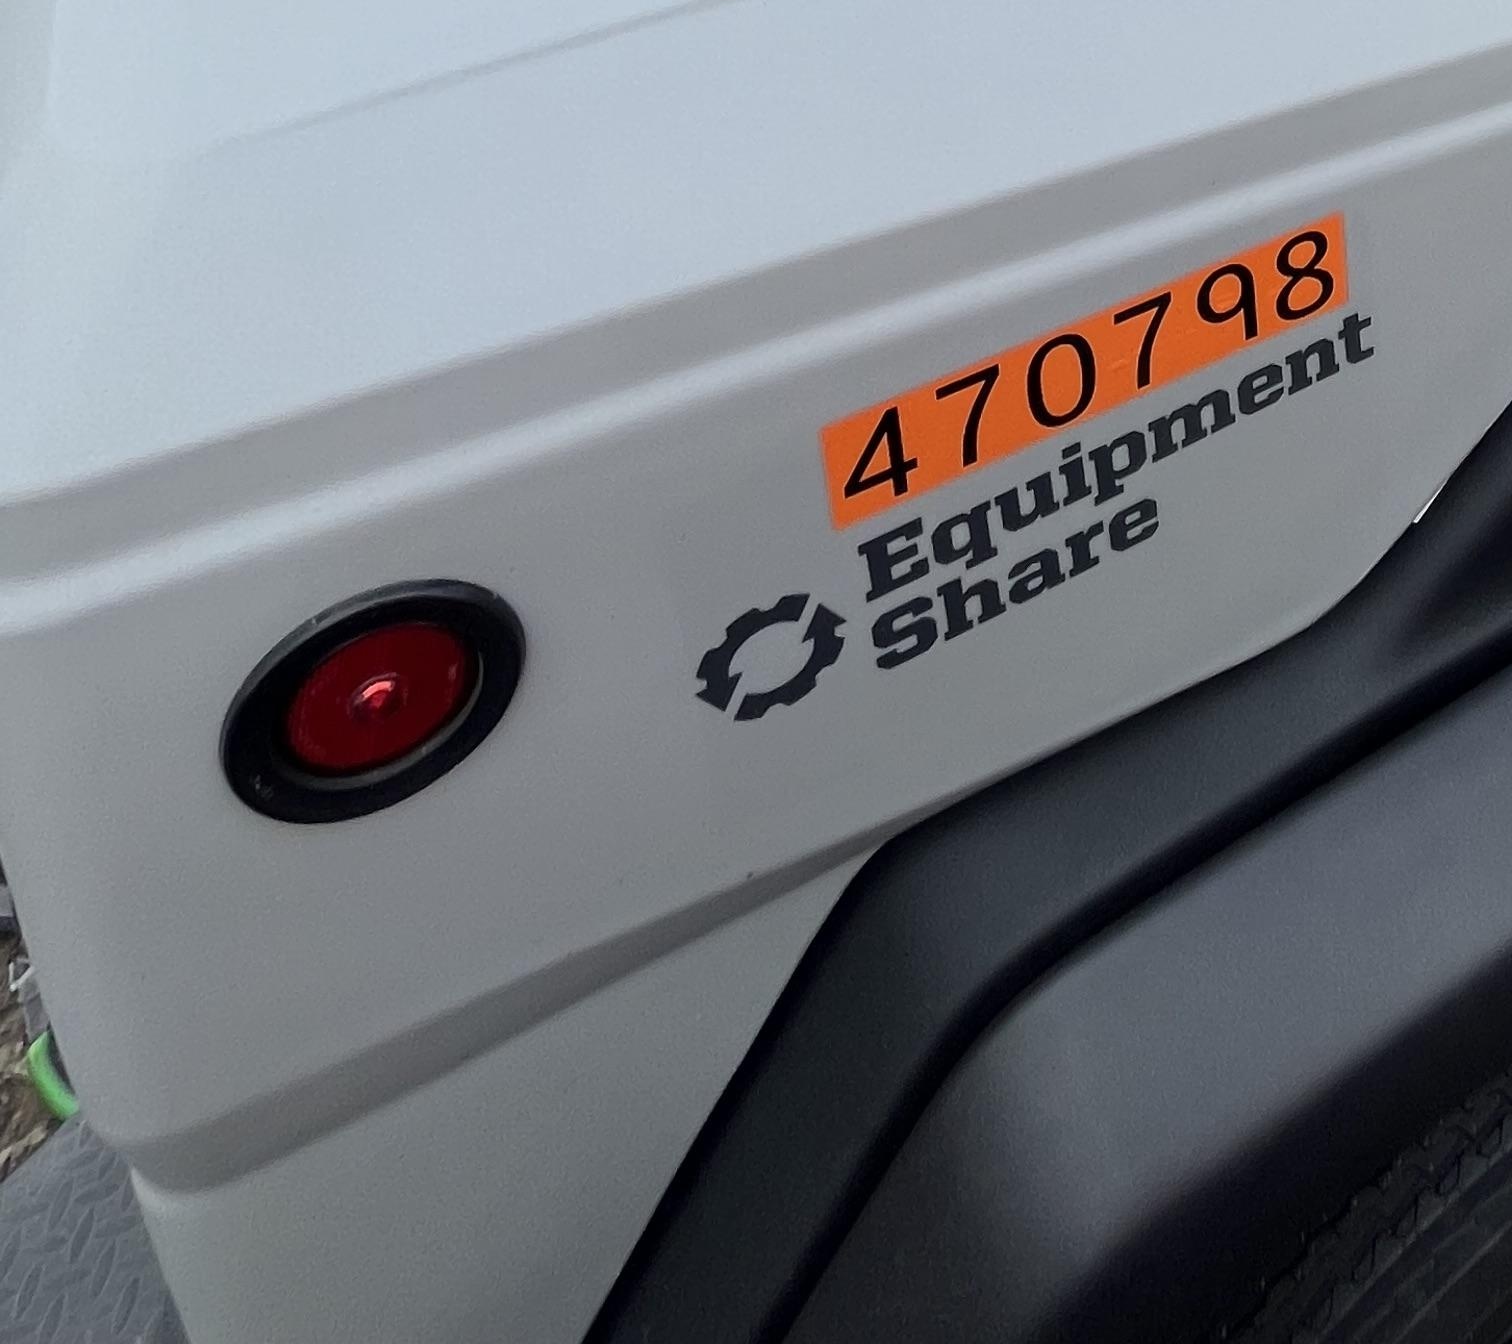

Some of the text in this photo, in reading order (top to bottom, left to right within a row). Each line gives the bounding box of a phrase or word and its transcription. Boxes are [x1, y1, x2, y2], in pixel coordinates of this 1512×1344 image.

[842, 230, 1336, 499] 470798
[857, 312, 1376, 603] Equipment
[870, 499, 1160, 670] Share
